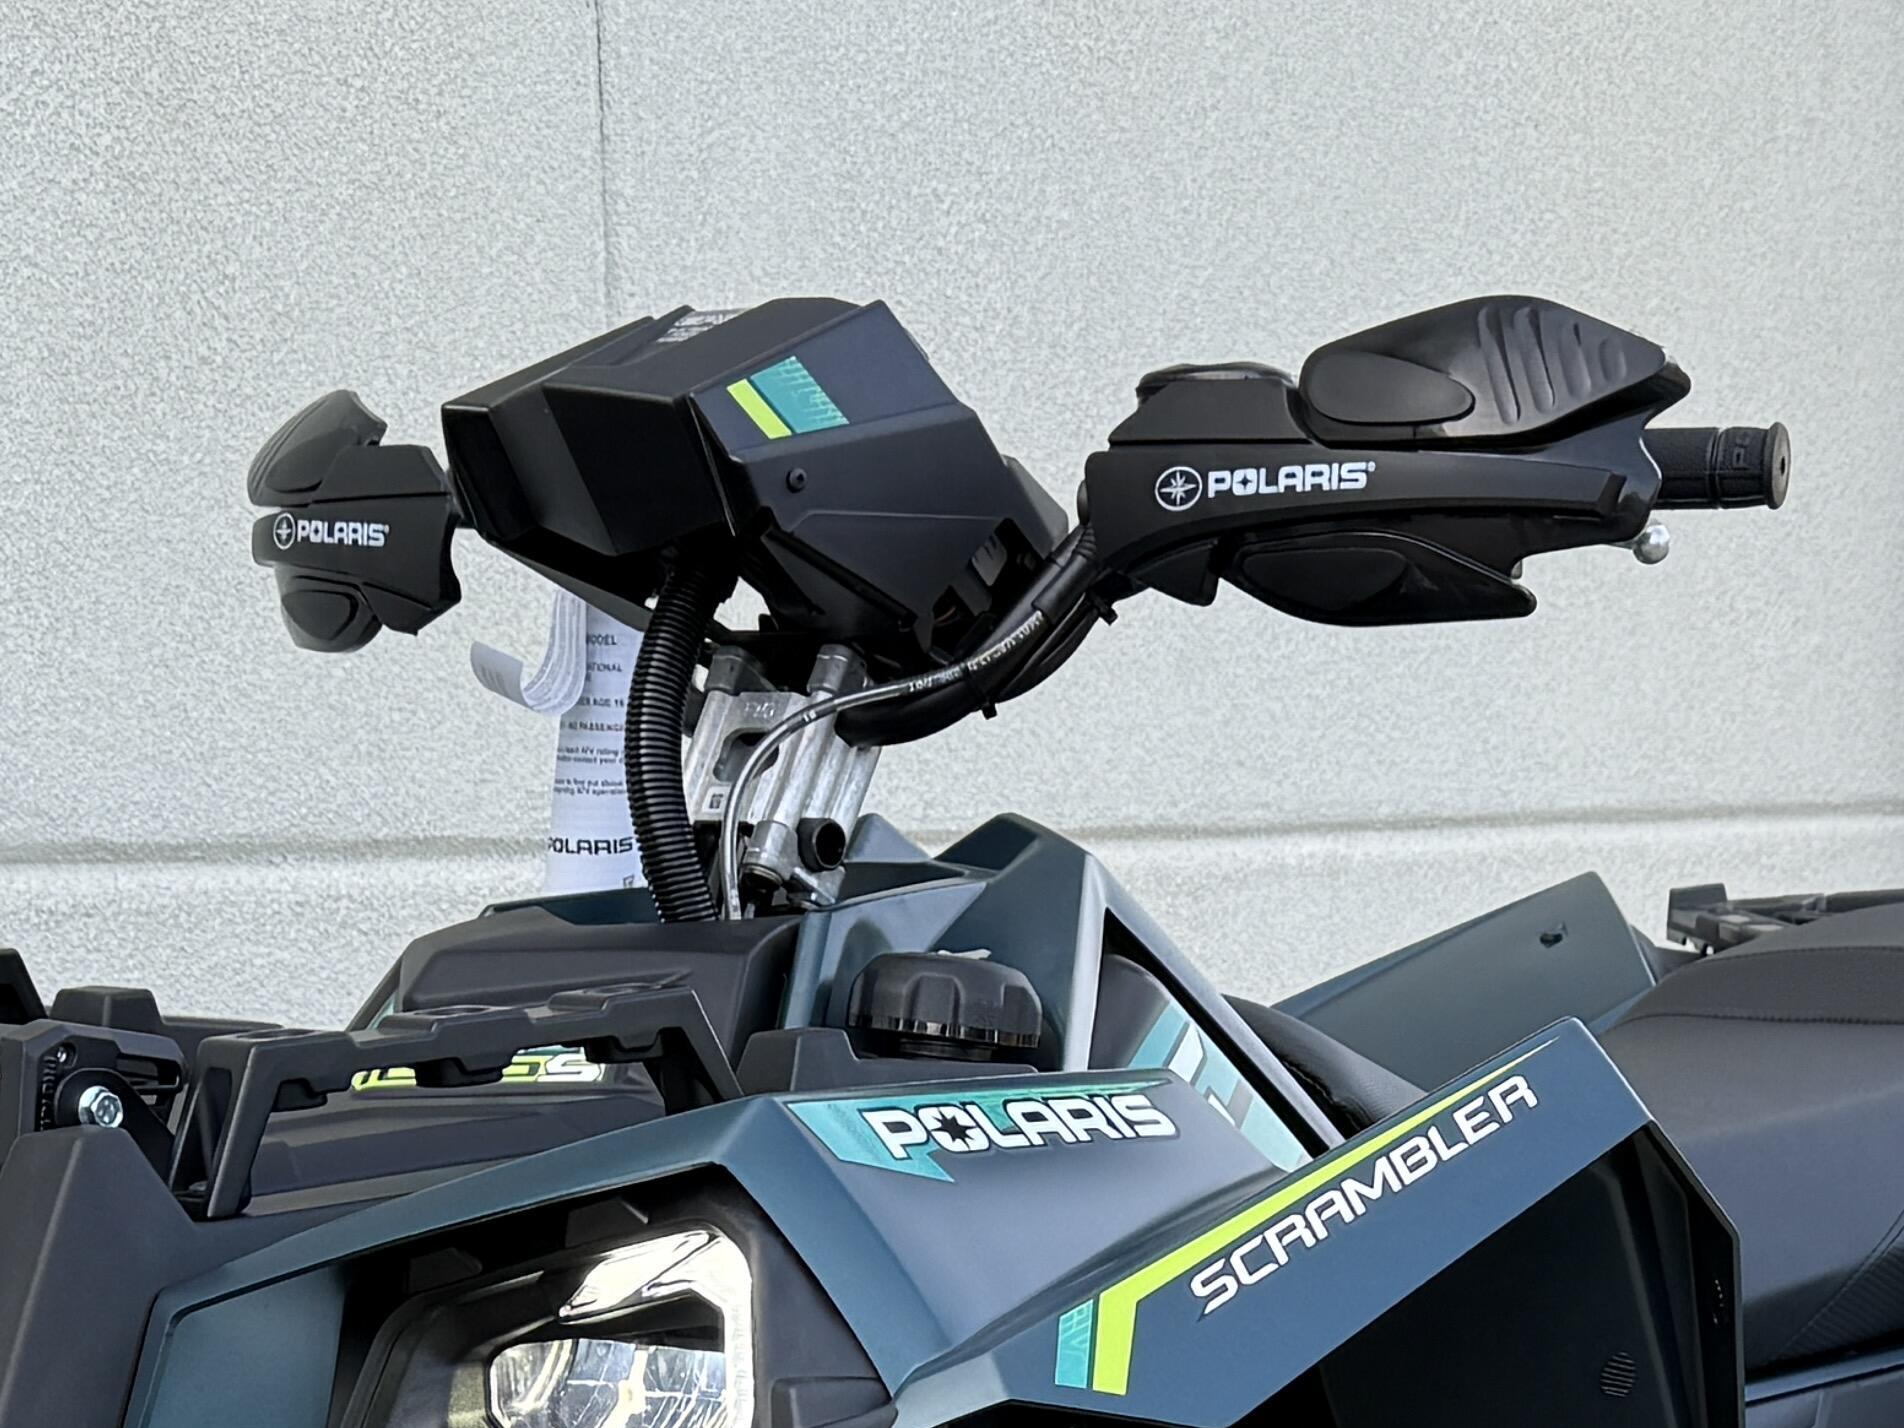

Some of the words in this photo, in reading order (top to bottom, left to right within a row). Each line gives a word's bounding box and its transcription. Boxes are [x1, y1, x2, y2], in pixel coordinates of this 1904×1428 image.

[1207, 460, 1368, 499] POLARIS
[296, 518, 385, 547] POLARIS
[859, 1091, 1177, 1162] POLARIS
[1189, 1074, 1540, 1321] SCRAMBLER
